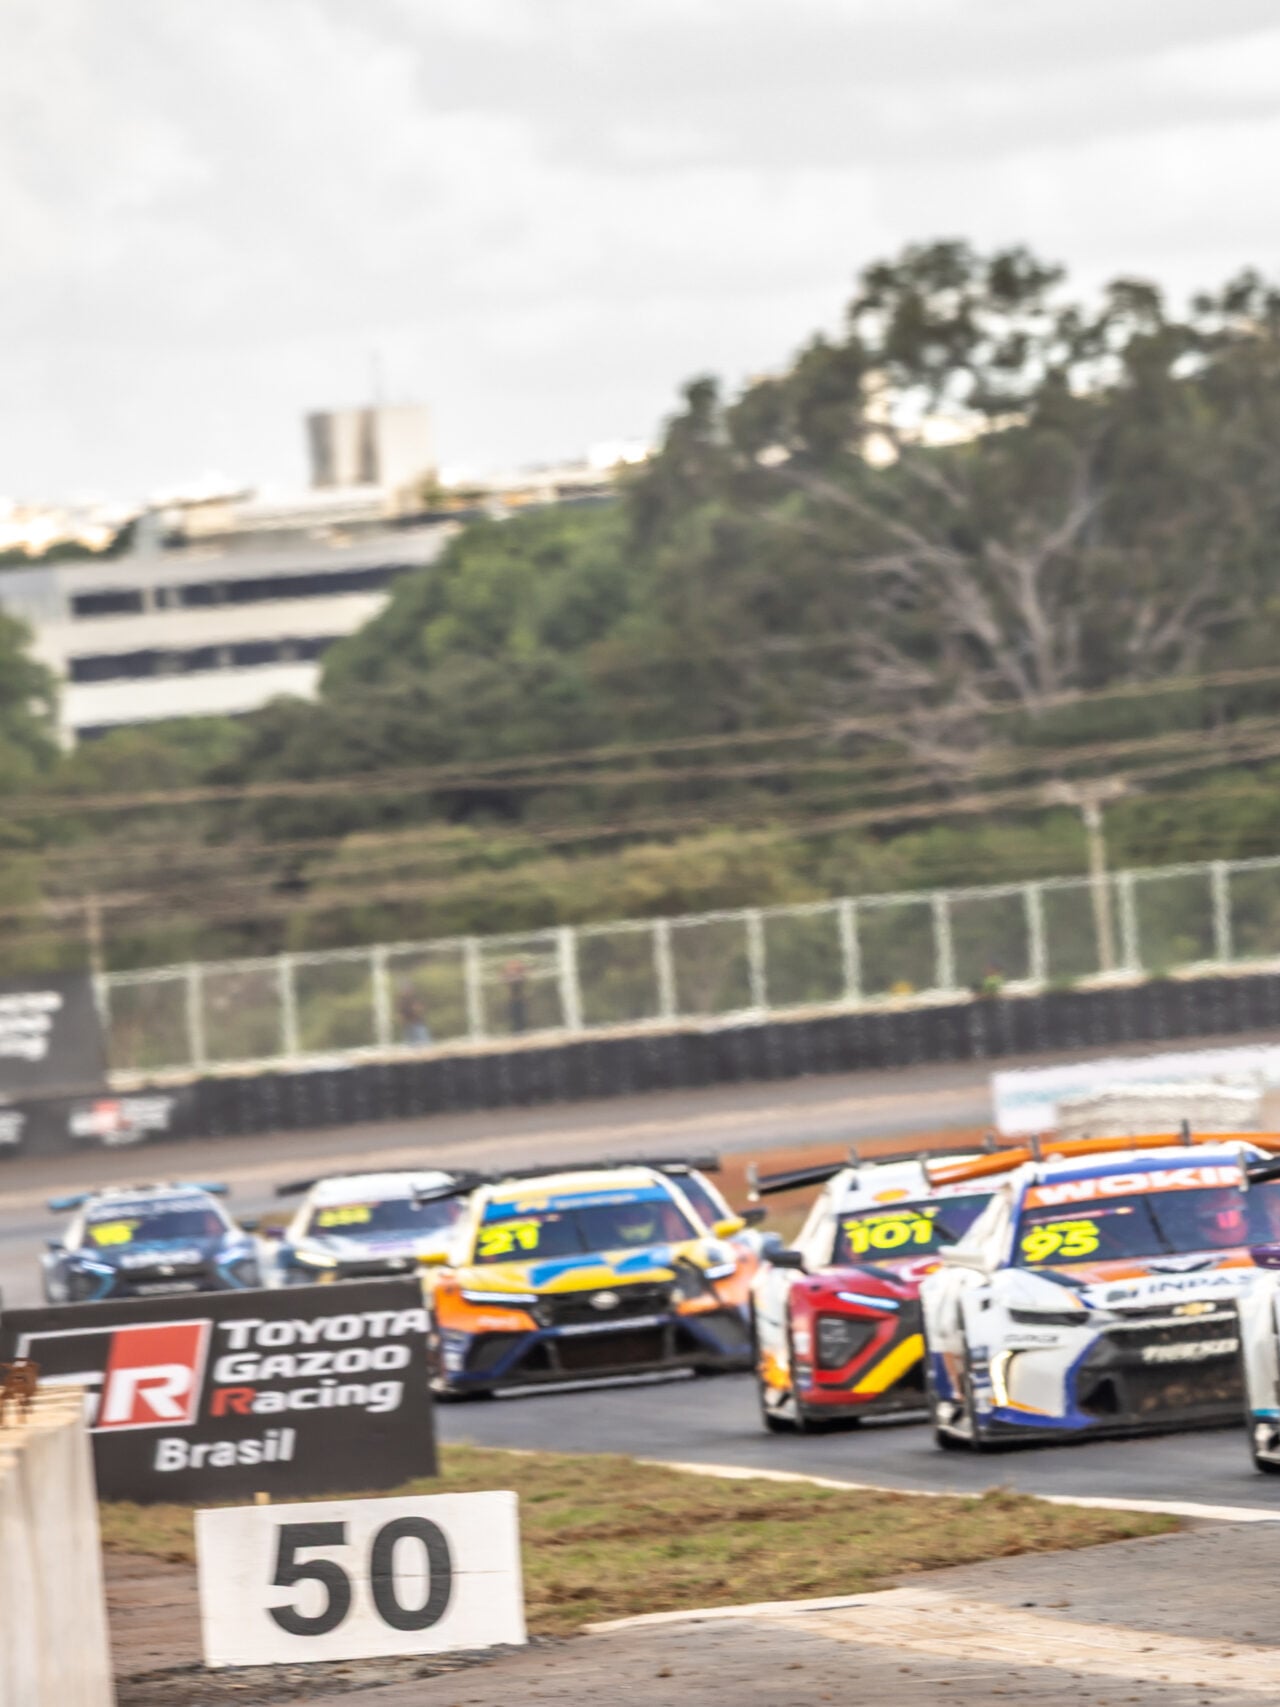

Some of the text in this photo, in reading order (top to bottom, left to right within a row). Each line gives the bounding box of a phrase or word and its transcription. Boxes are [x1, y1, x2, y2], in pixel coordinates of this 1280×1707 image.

[479, 1228, 539, 1256] 21
[847, 1219, 933, 1254] 101
[1021, 1229, 1099, 1262] 95
[217, 1308, 431, 1350] TOYOTA
[213, 1344, 411, 1384] GAZOO
[210, 1378, 404, 1417] Racing
[154, 1428, 296, 1473] Brasil
[266, 1516, 453, 1637] 50
